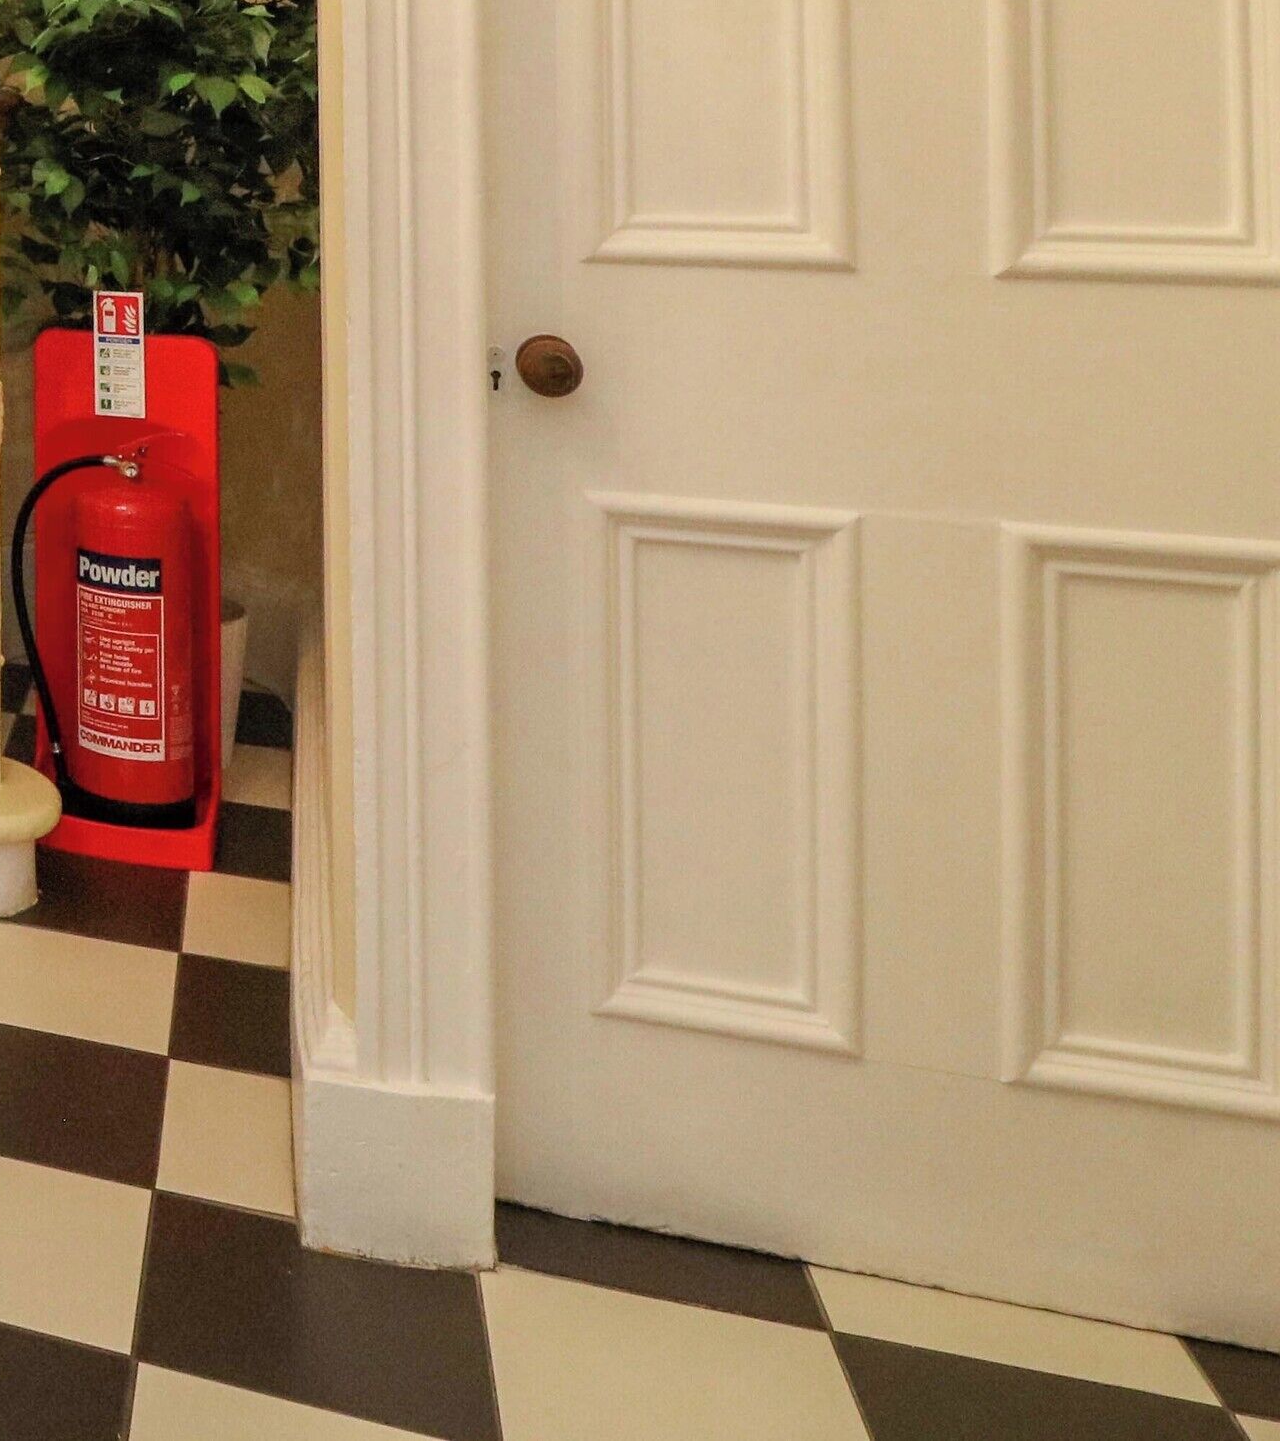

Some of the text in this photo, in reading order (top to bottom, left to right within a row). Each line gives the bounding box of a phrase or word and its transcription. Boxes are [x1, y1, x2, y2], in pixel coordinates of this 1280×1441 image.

[79, 555, 160, 588] Powder
[94, 594, 152, 610] EXTINGUISHER
[80, 729, 161, 753] COMMANDER
